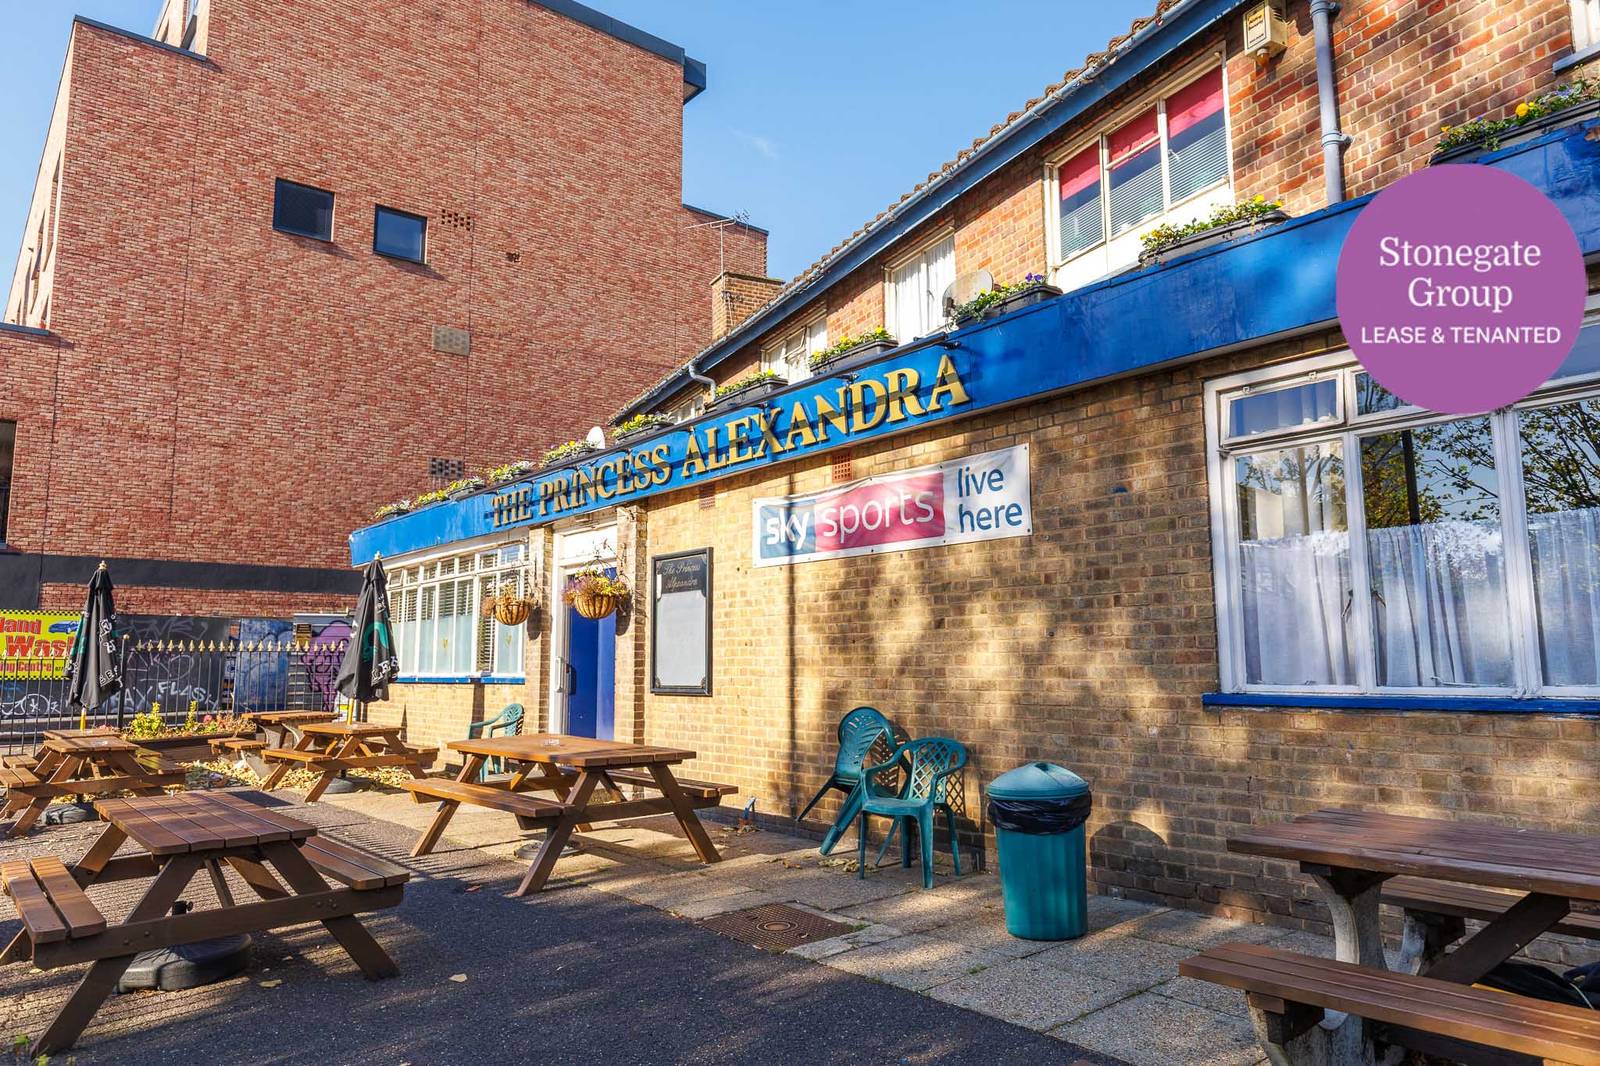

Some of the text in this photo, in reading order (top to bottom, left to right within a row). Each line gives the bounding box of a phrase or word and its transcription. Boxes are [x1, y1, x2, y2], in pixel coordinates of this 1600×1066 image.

[491, 354, 970, 528] THE PRINCESS ALEXANDRA
[957, 467, 1005, 497] live
[765, 489, 936, 549] sky sports
[958, 502, 1023, 534] here
